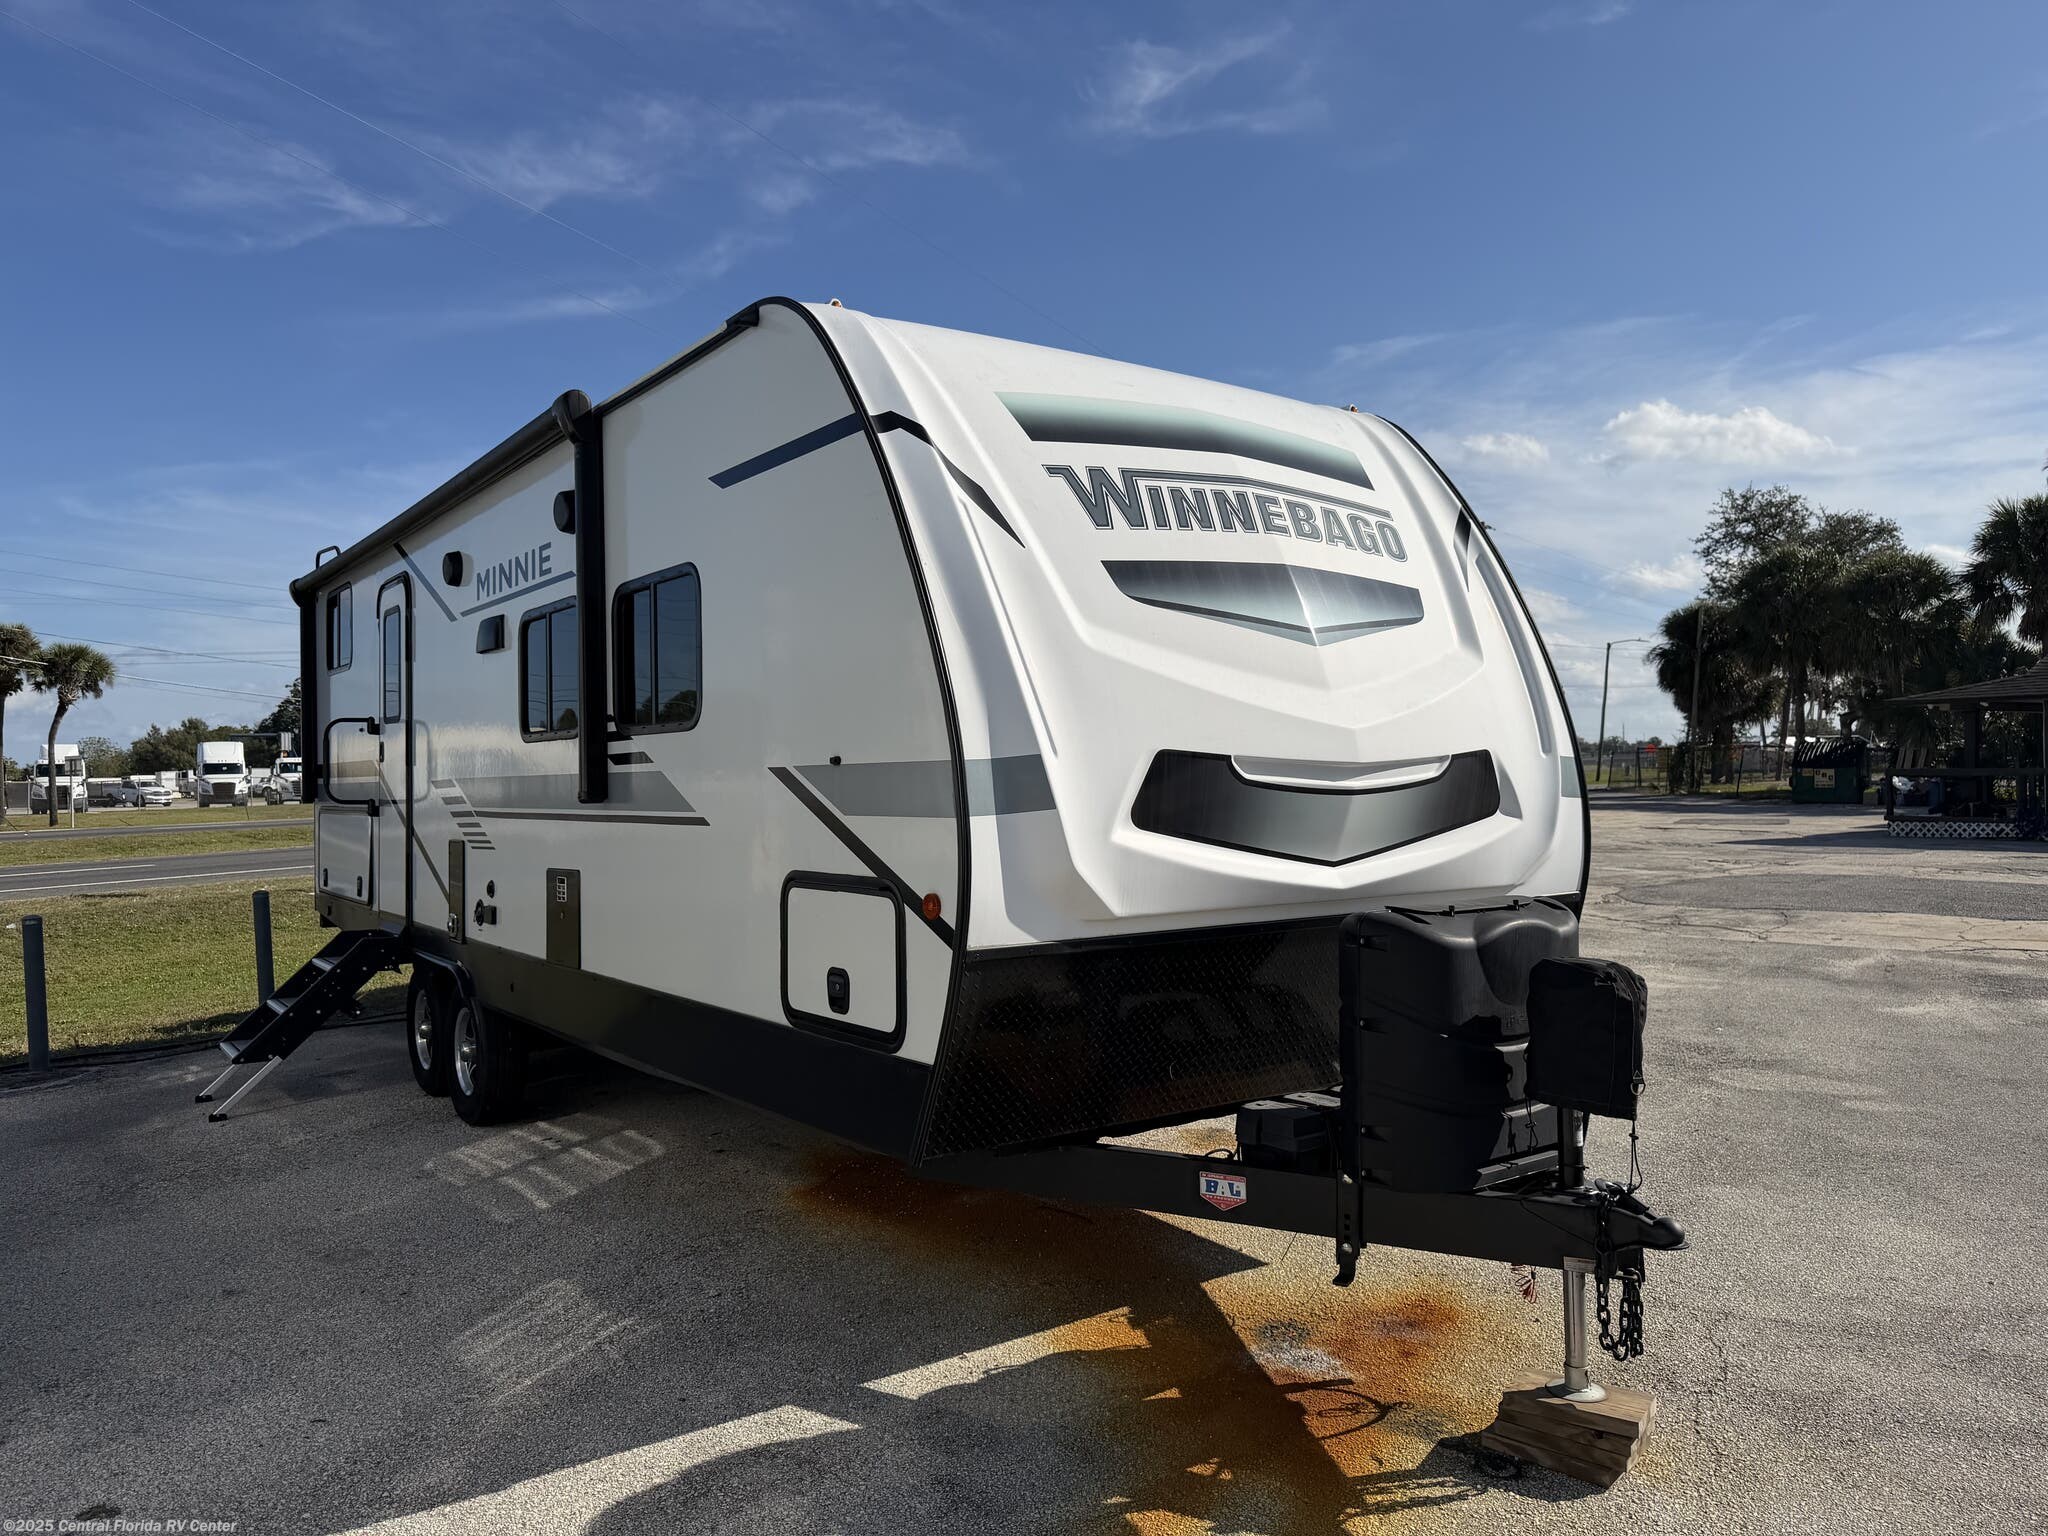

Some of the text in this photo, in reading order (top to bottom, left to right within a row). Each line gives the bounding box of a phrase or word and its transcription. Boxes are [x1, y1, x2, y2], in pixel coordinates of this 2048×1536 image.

[1041, 464, 1408, 562] WINNEBAGO
[476, 541, 553, 601] MINNIE
[1205, 1179, 1241, 1197] BAL
